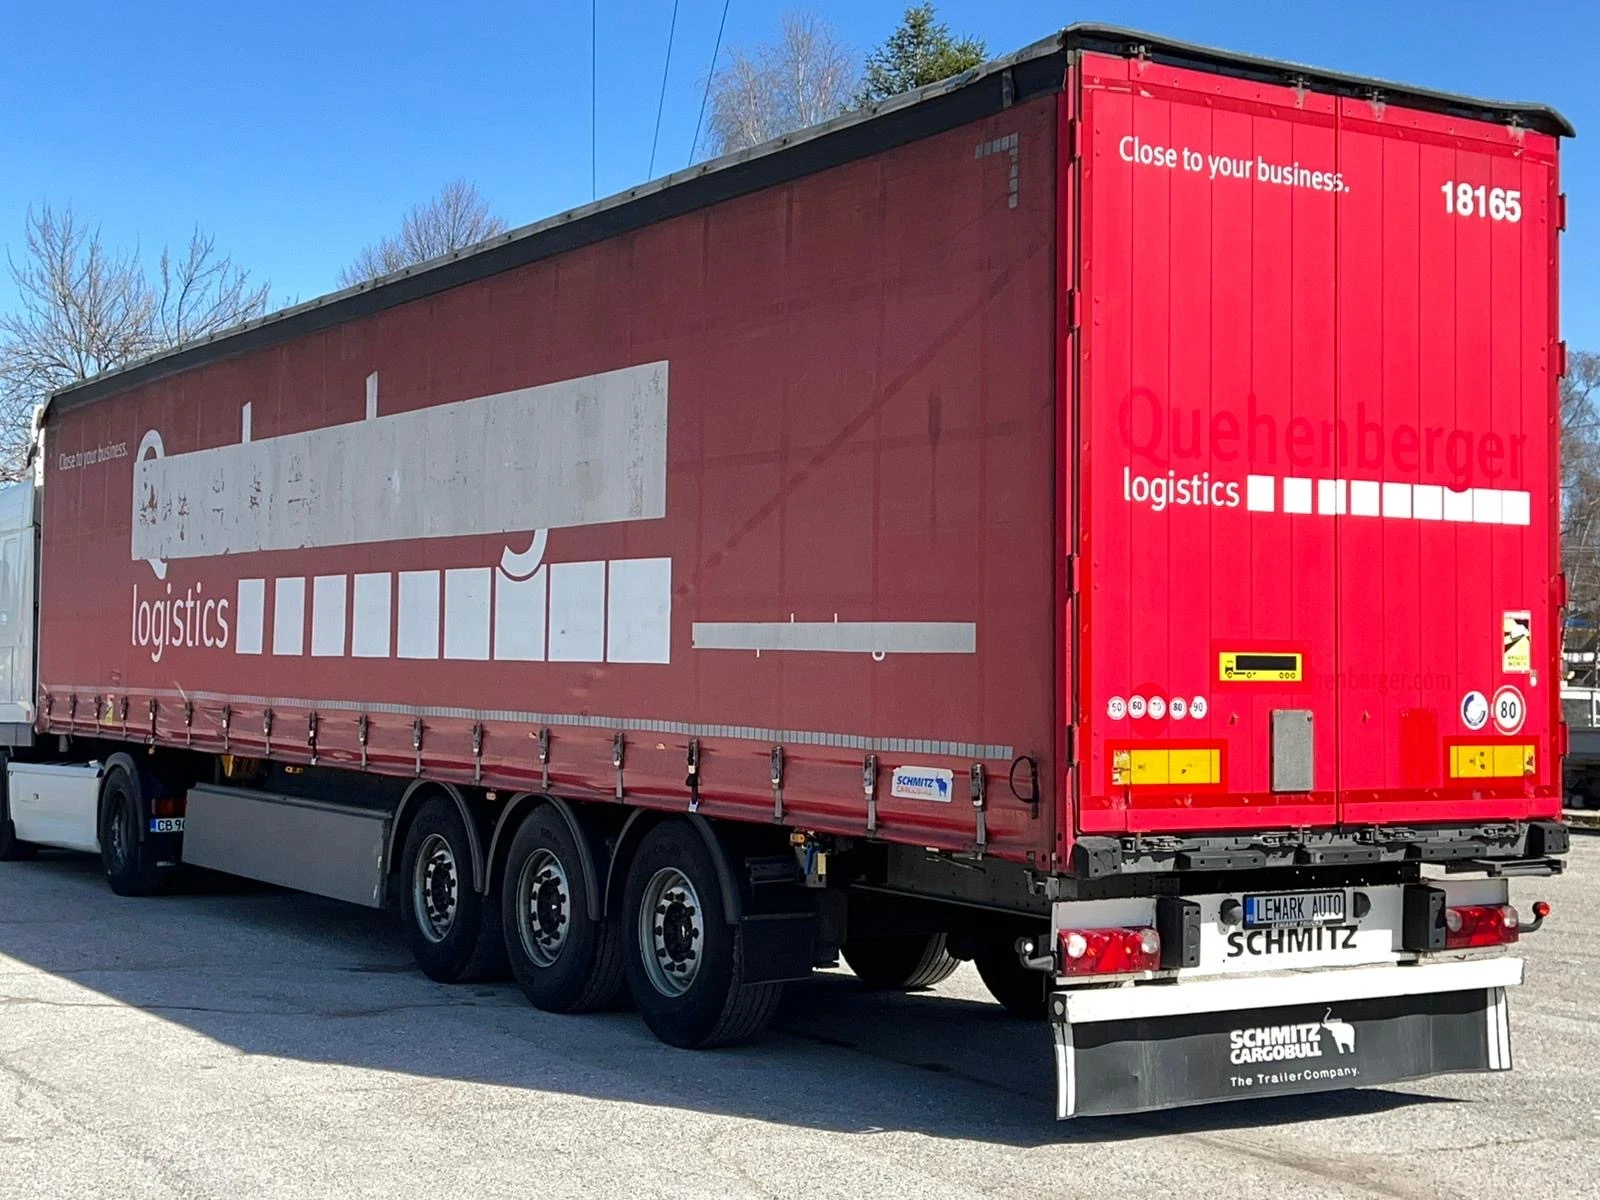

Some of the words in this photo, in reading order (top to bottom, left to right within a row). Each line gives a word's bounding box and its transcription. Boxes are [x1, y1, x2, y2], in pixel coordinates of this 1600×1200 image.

[1119, 135, 1177, 167] Close
[1182, 147, 1203, 172] to
[1208, 154, 1253, 179] your
[1257, 156, 1350, 192] business.
[1441, 180, 1522, 223] 18165
[1118, 386, 1527, 492] Quehenberger
[59, 452, 76, 470] Close
[1123, 466, 1240, 512] logistics
[132, 581, 229, 663] logistics
[1500, 700, 1517, 719] 80
[896, 775, 934, 788] SCHMITZ
[1257, 896, 1305, 922] LEMARK
[1312, 894, 1342, 918] AUTO
[1227, 925, 1358, 957] SCHMITZ
[1230, 1022, 1321, 1049] SCHMITZ
[1230, 1041, 1322, 1065] CARGOBULL
[1230, 1076, 1253, 1088] The
